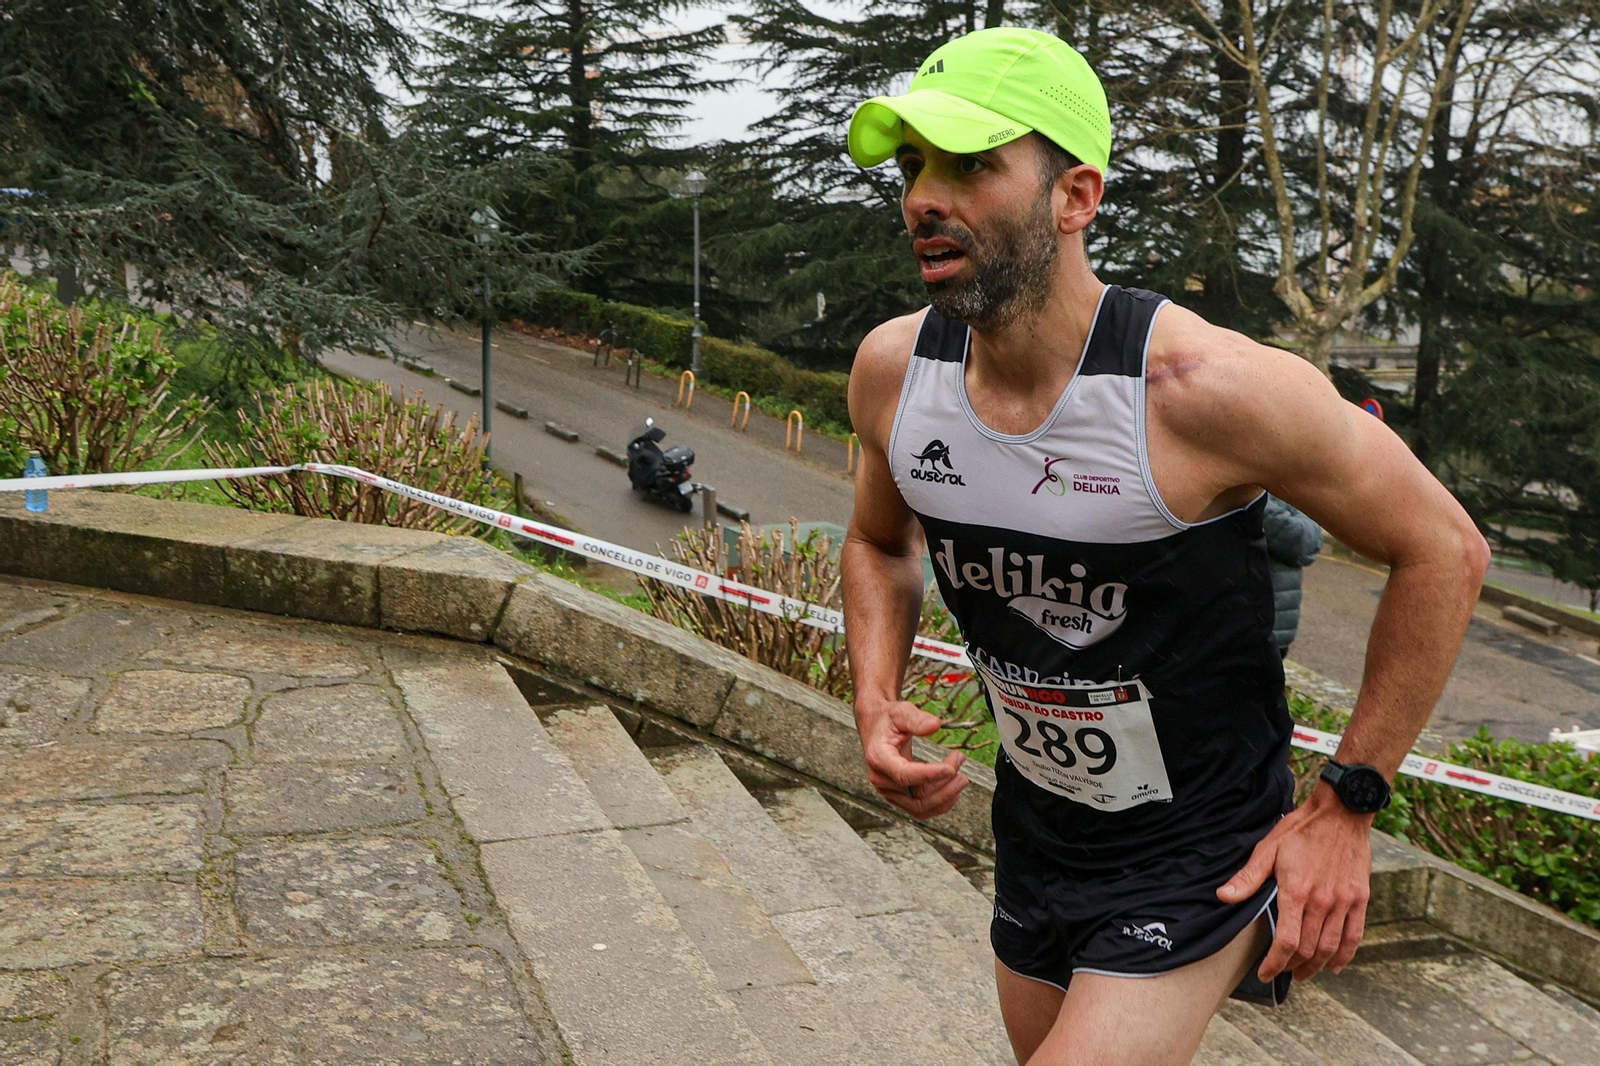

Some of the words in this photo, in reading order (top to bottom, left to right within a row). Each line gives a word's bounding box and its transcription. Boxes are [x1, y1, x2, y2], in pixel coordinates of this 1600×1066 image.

[988, 128, 1016, 144] ADIZERO
[910, 468, 967, 487] austral
[1088, 475, 1121, 483] DEPORTIVO
[1073, 482, 1121, 495] DELIKIA
[448, 499, 464, 511] DE
[468, 507, 495, 521] VIGO
[583, 543, 643, 567] CONCELLO
[645, 561, 662, 574] DE
[665, 568, 692, 582] VIGO
[936, 539, 1128, 617] delikia
[1041, 609, 1092, 634] fresh
[1034, 705, 1050, 717] AO
[1051, 709, 1103, 721] CASTRO
[1003, 706, 1117, 775] 289
[1131, 788, 1159, 801] amura
